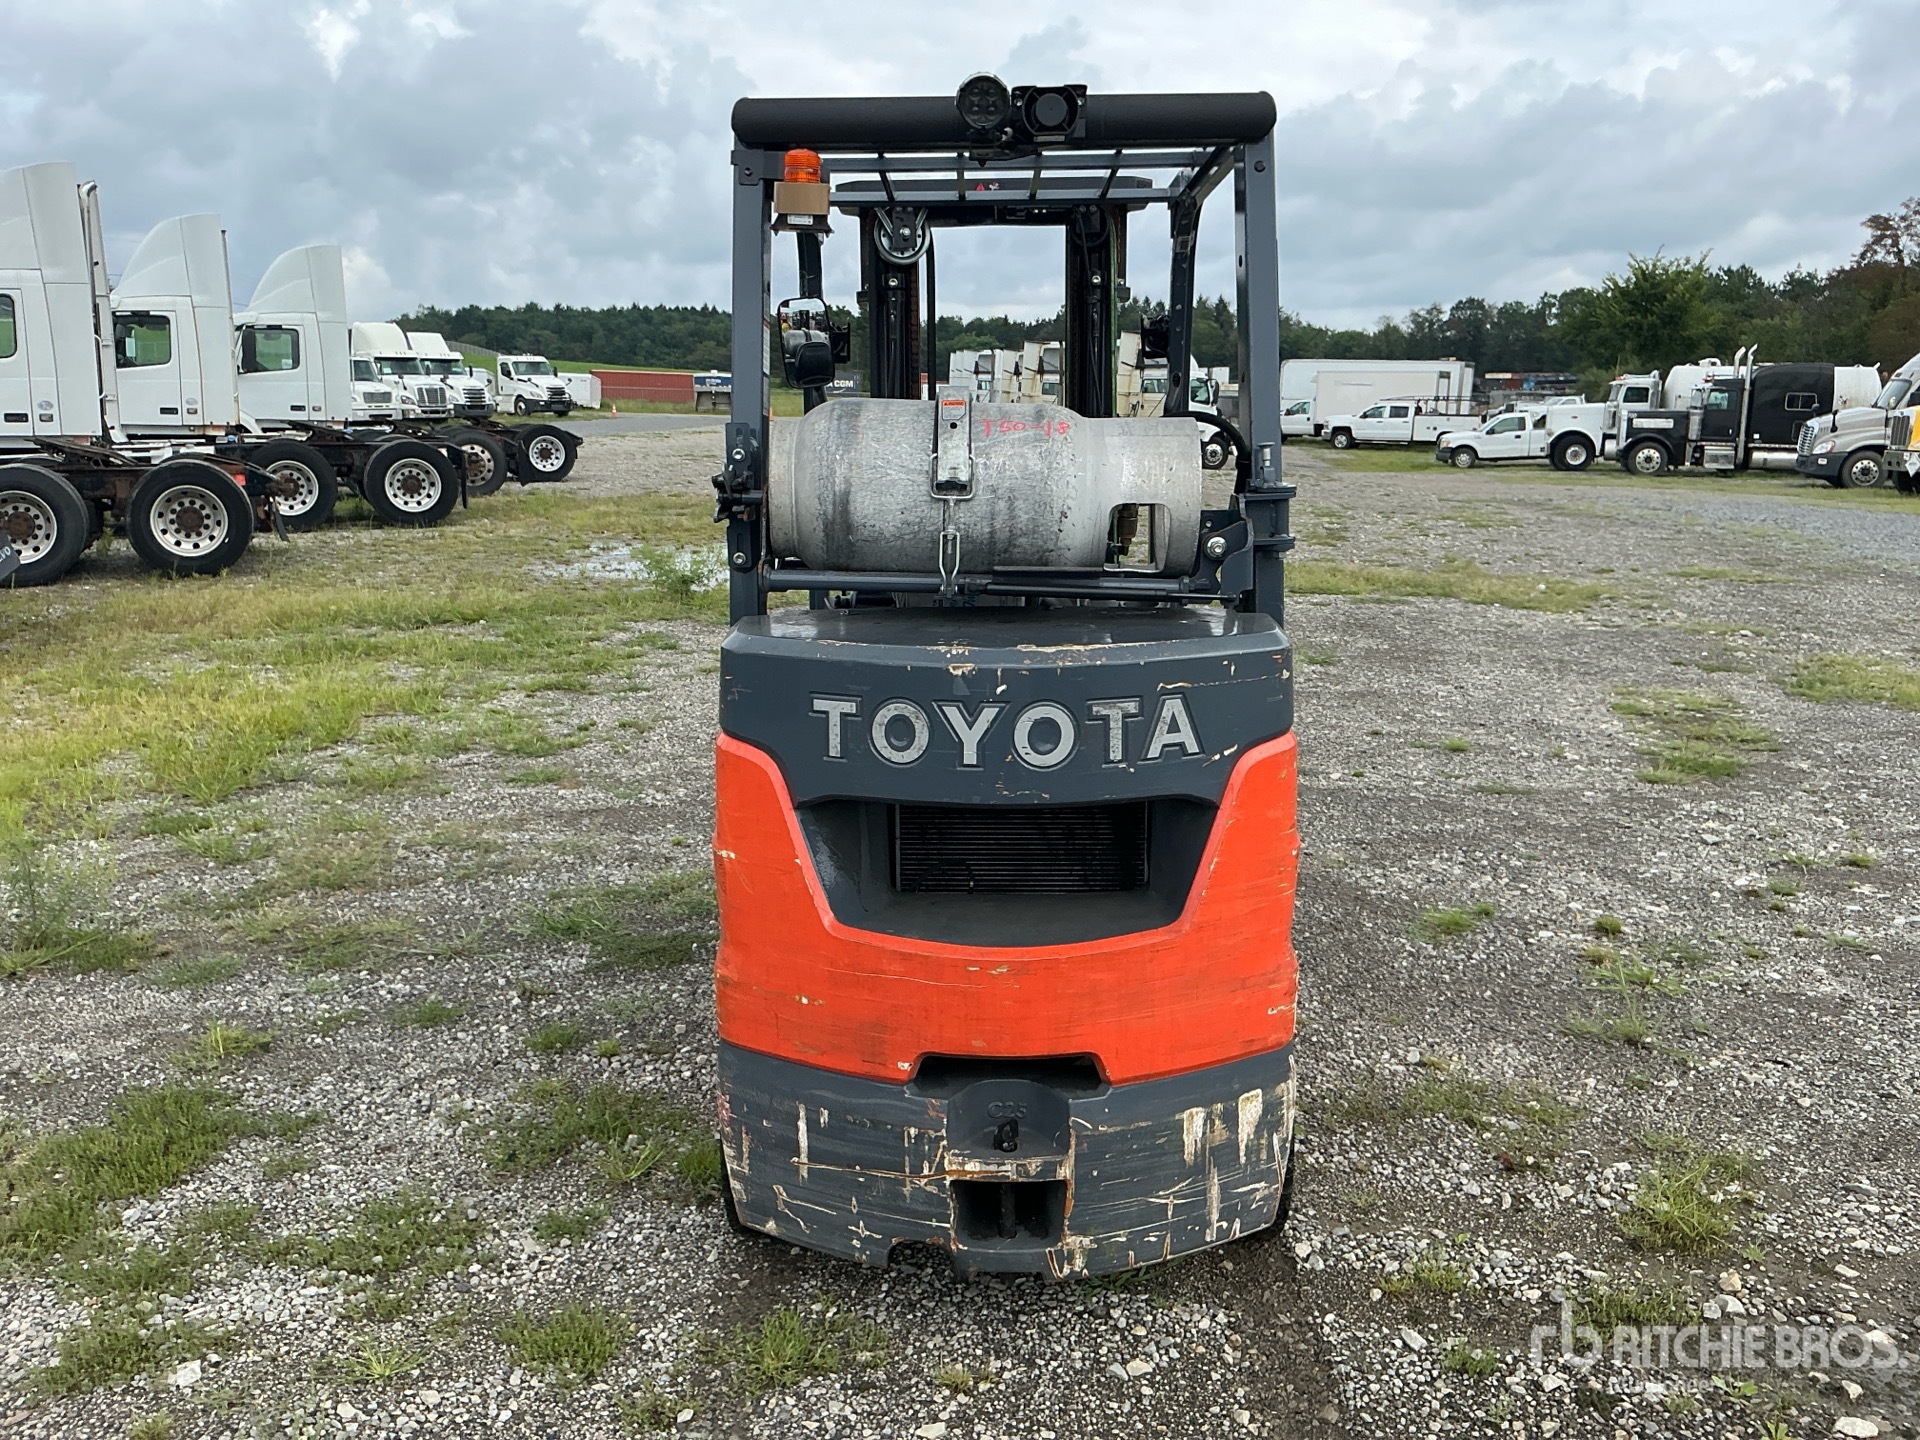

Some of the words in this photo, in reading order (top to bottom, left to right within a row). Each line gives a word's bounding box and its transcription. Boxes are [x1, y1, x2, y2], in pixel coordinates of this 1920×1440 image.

[833, 379, 854, 388] CGM
[811, 696, 1203, 768] TOYOTA
[987, 1101, 1028, 1118] C25
